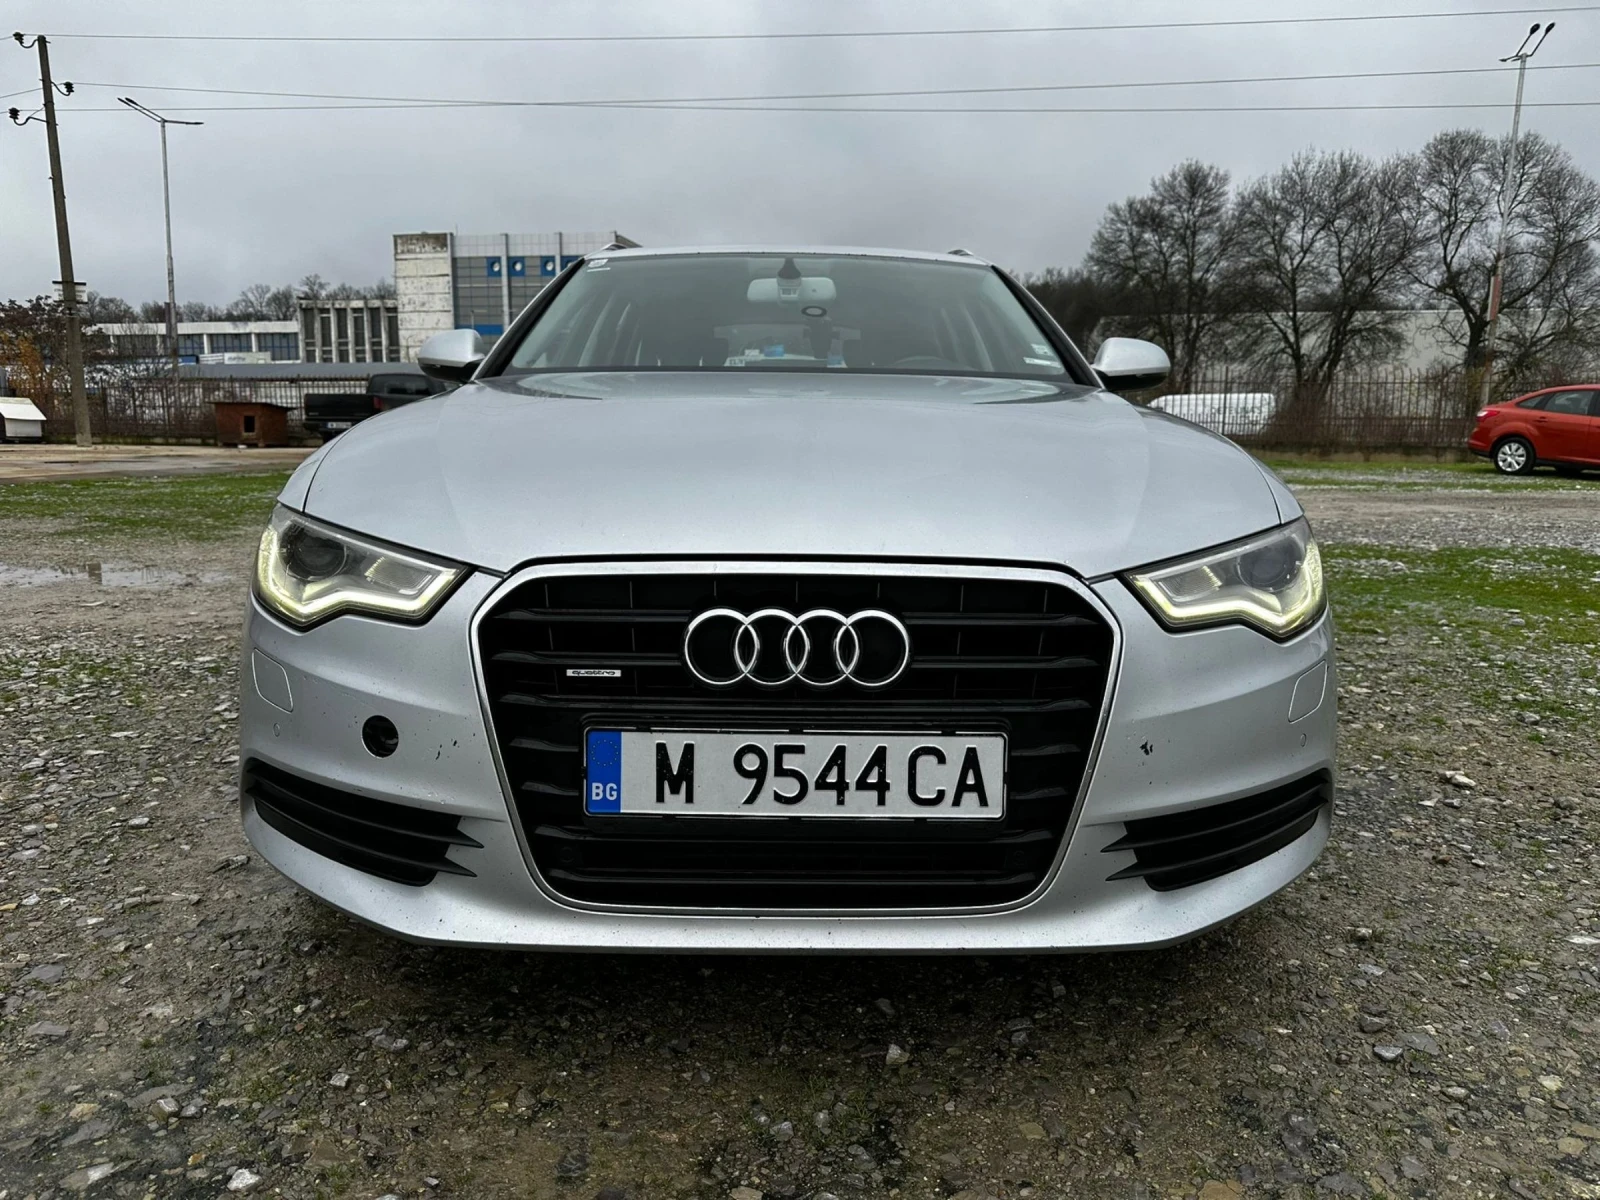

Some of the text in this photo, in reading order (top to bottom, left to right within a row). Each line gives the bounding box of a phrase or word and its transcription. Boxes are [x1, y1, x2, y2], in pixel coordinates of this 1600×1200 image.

[591, 782, 618, 801] BG
[655, 741, 989, 807] M 9544 CA
